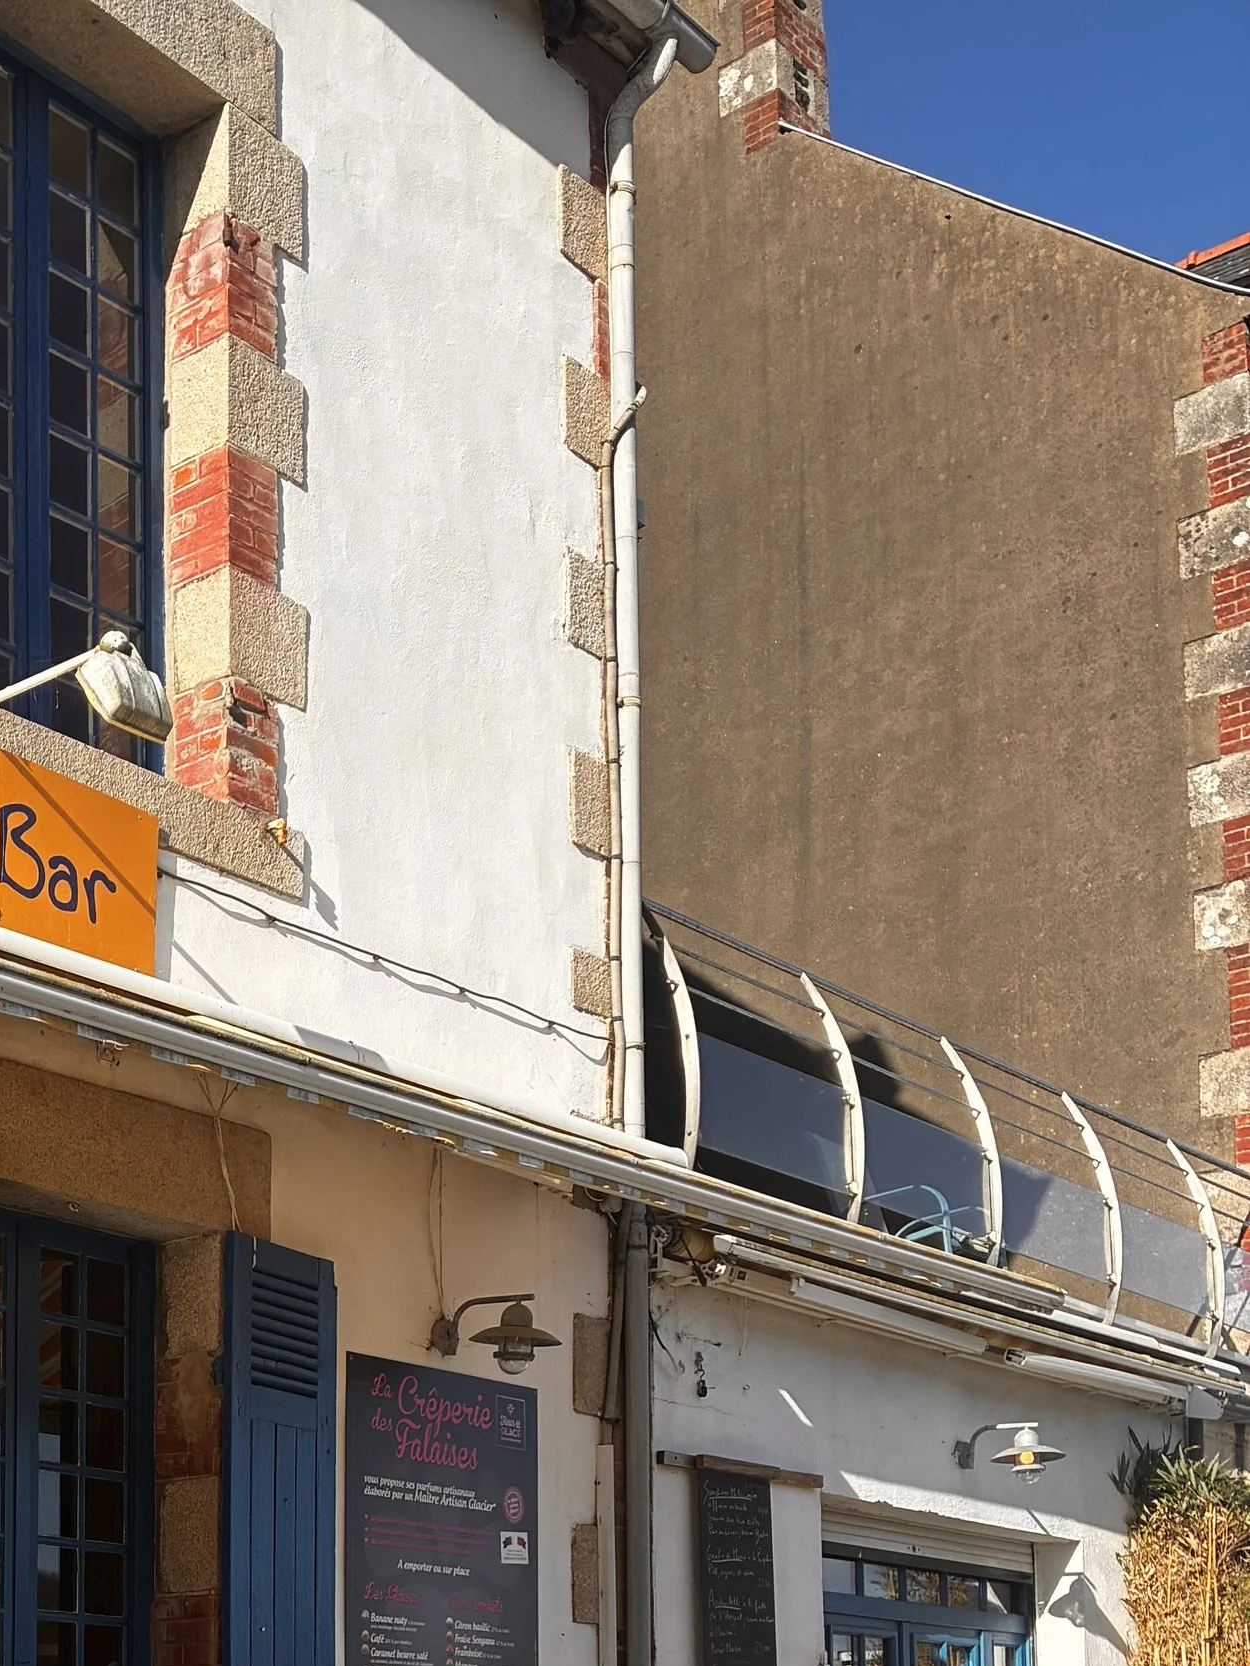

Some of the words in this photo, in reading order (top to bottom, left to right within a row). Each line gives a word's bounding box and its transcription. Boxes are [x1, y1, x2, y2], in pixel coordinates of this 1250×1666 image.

[372, 1373, 393, 1399] La
[397, 1375, 493, 1436] Crêperie
[371, 1407, 394, 1431] des
[395, 1418, 479, 1470] Falaises
[363, 1475, 379, 1485] vous
[380, 1477, 405, 1489] propose
[405, 1481, 415, 1489] ses
[416, 1481, 442, 1495] parfums
[391, 1491, 404, 1501] par
[404, 1493, 414, 1501] un
[440, 1494, 467, 1509] Artisan
[403, 1562, 433, 1573] emporter
[433, 1565, 442, 1573] ou
[442, 1565, 453, 1574] sur
[453, 1566, 470, 1577] place
[370, 1633, 385, 1644] Café
[370, 1647, 396, 1658] Caramel
[396, 1649, 416, 1660] beurre
[416, 1651, 429, 1660] salé
